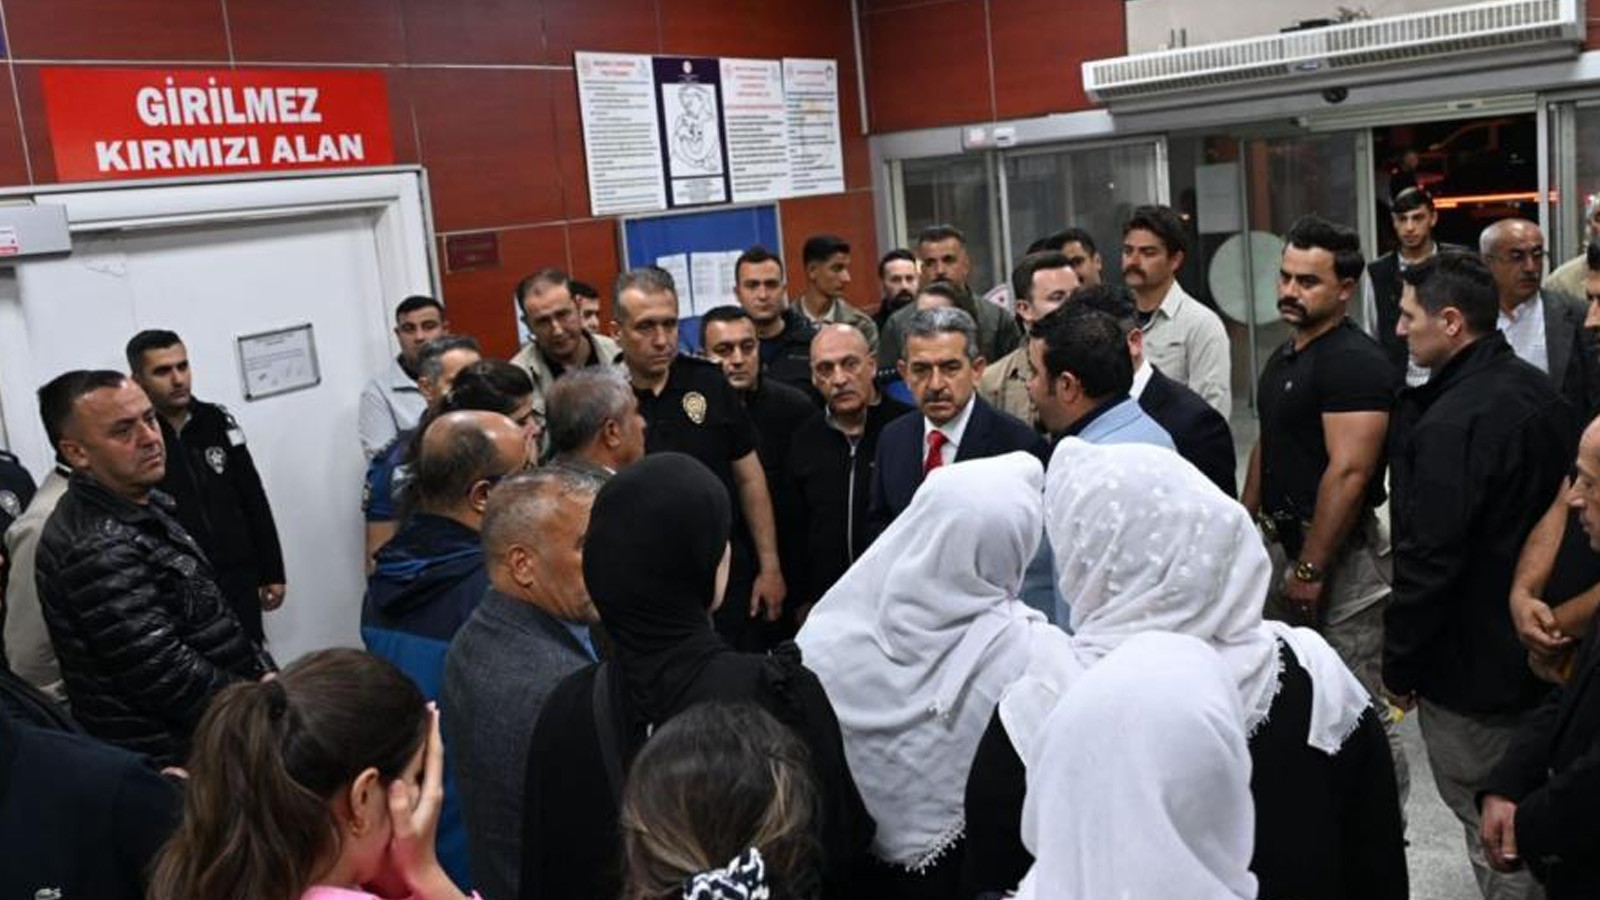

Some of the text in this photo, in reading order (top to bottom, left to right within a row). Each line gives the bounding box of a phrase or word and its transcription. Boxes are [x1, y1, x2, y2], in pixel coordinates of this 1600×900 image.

[137, 77, 321, 125] GİRİLMEZ
[96, 134, 364, 172] KIRMIZI ALAN
